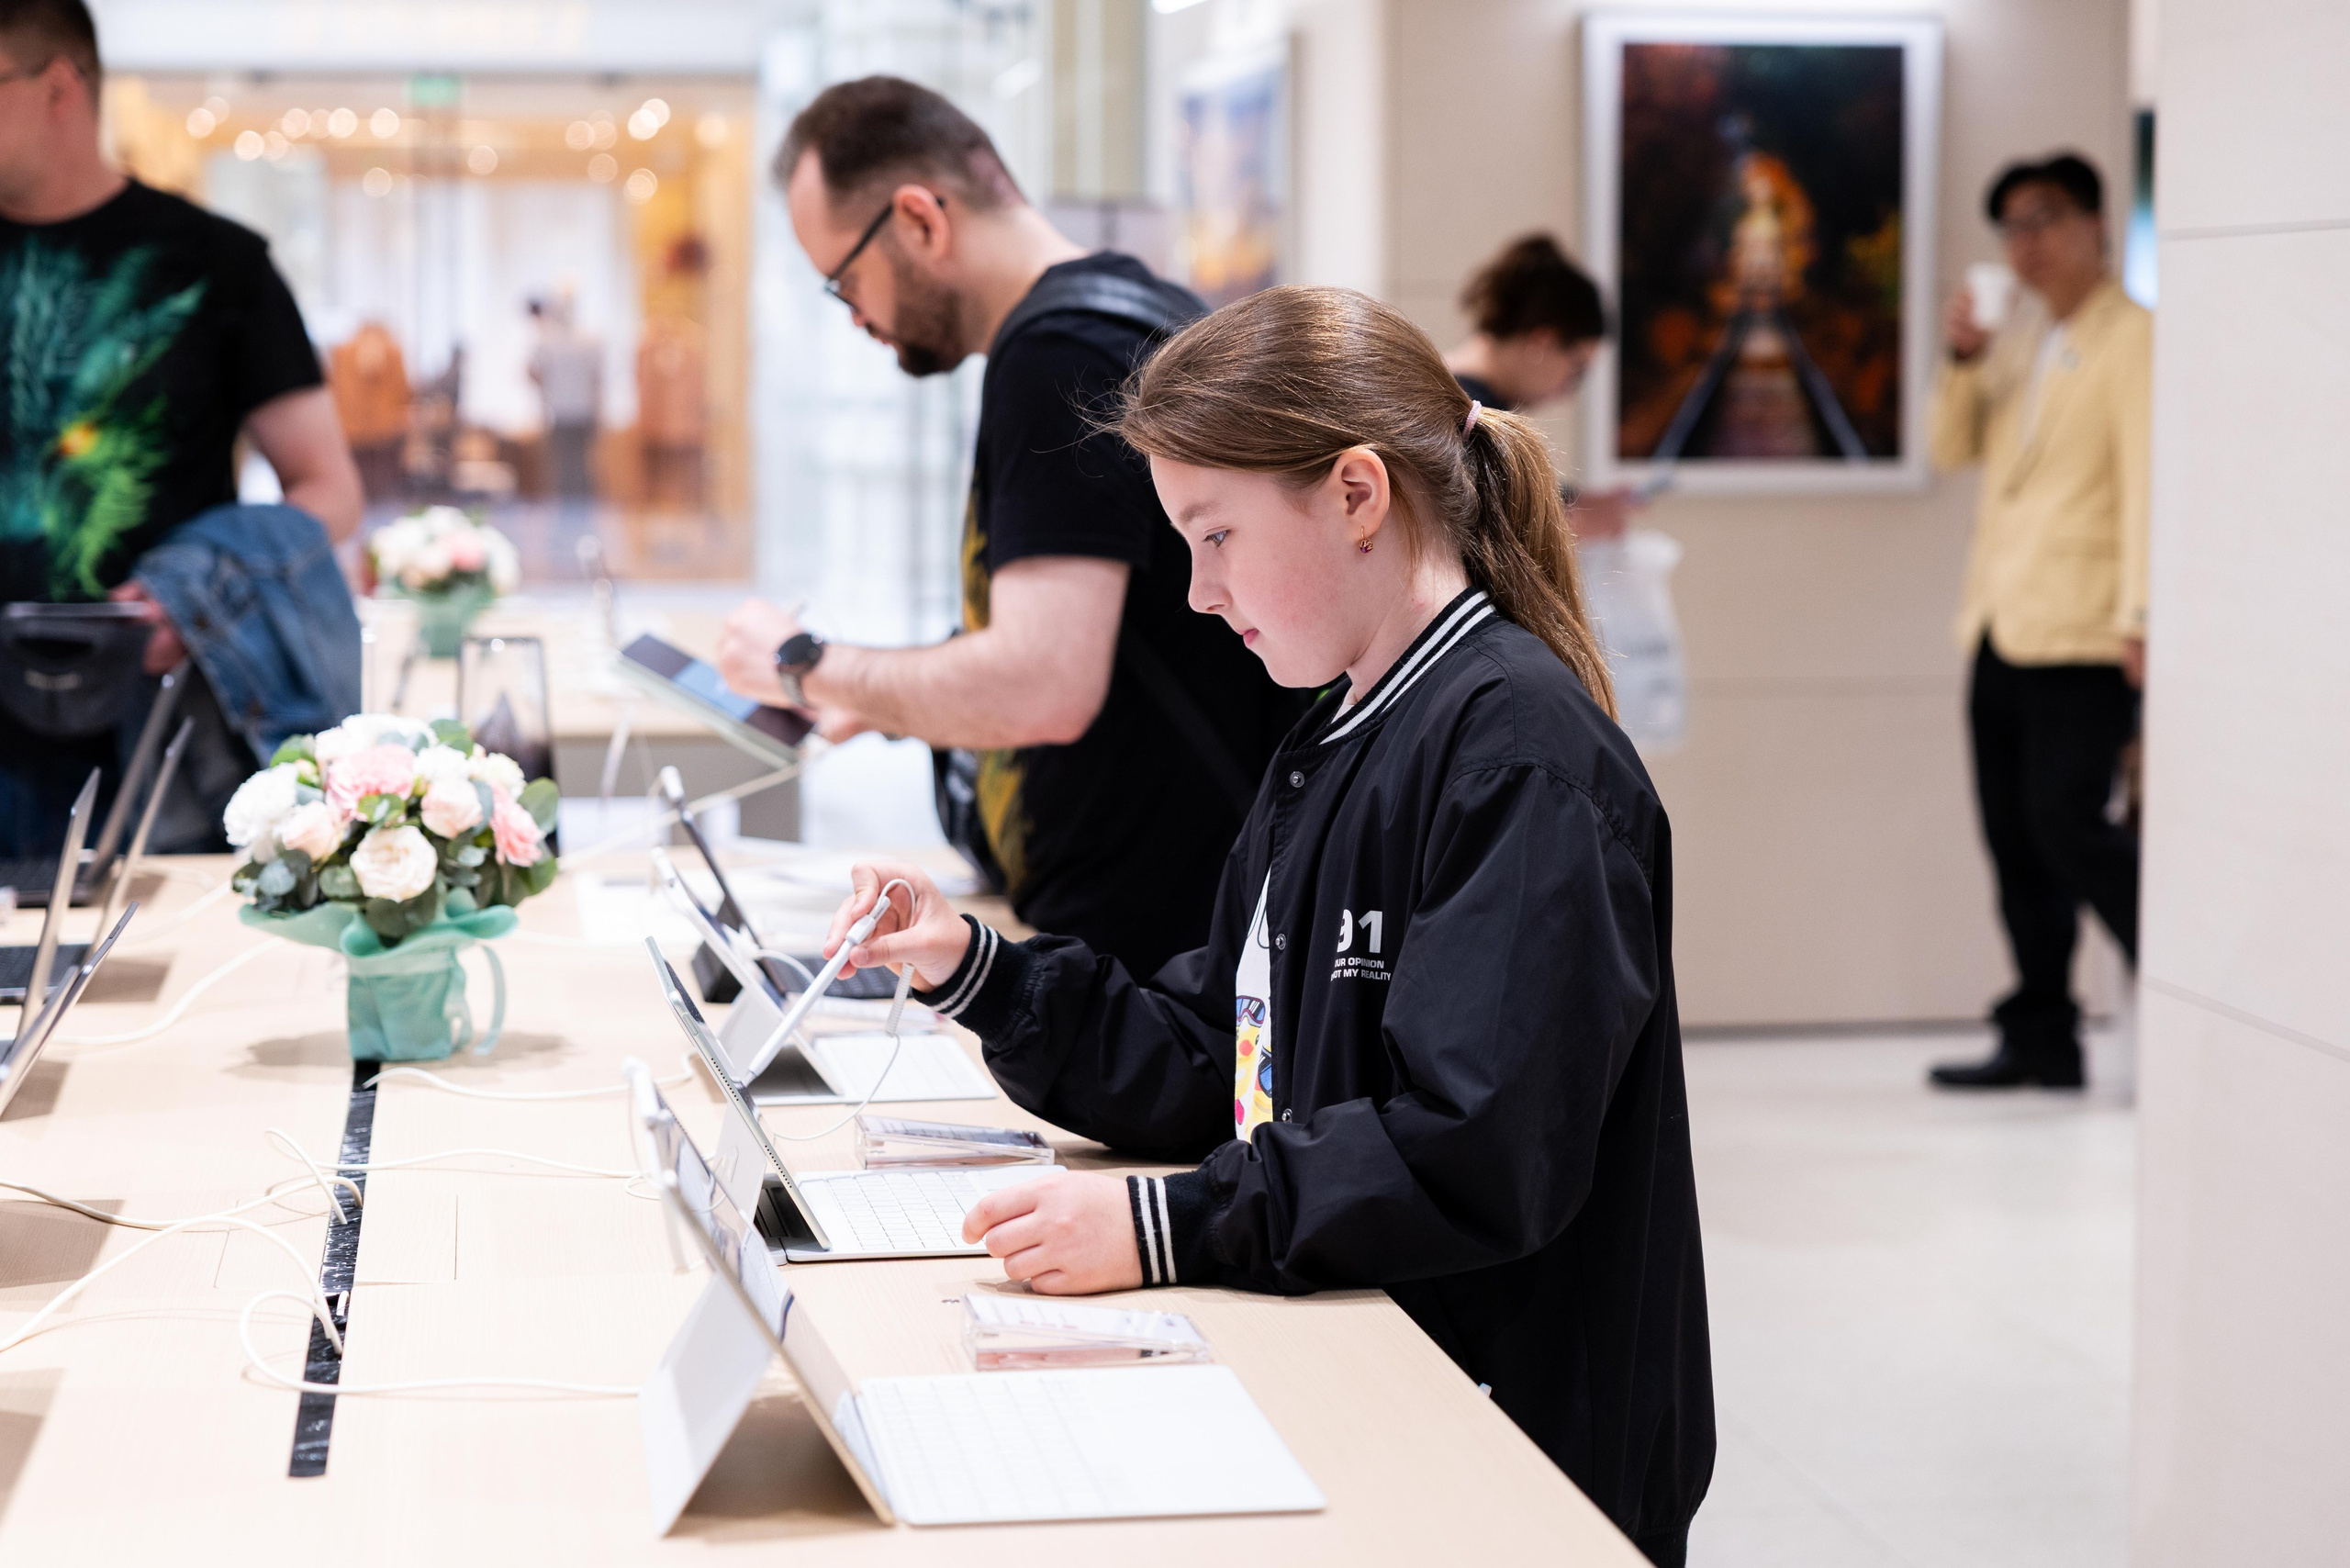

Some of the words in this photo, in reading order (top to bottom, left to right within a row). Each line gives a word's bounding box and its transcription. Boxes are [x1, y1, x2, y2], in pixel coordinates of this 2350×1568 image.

[1348, 958, 1384, 969] OPINION
[1343, 969, 1359, 977] MY
[1361, 969, 1391, 980] REALITY
